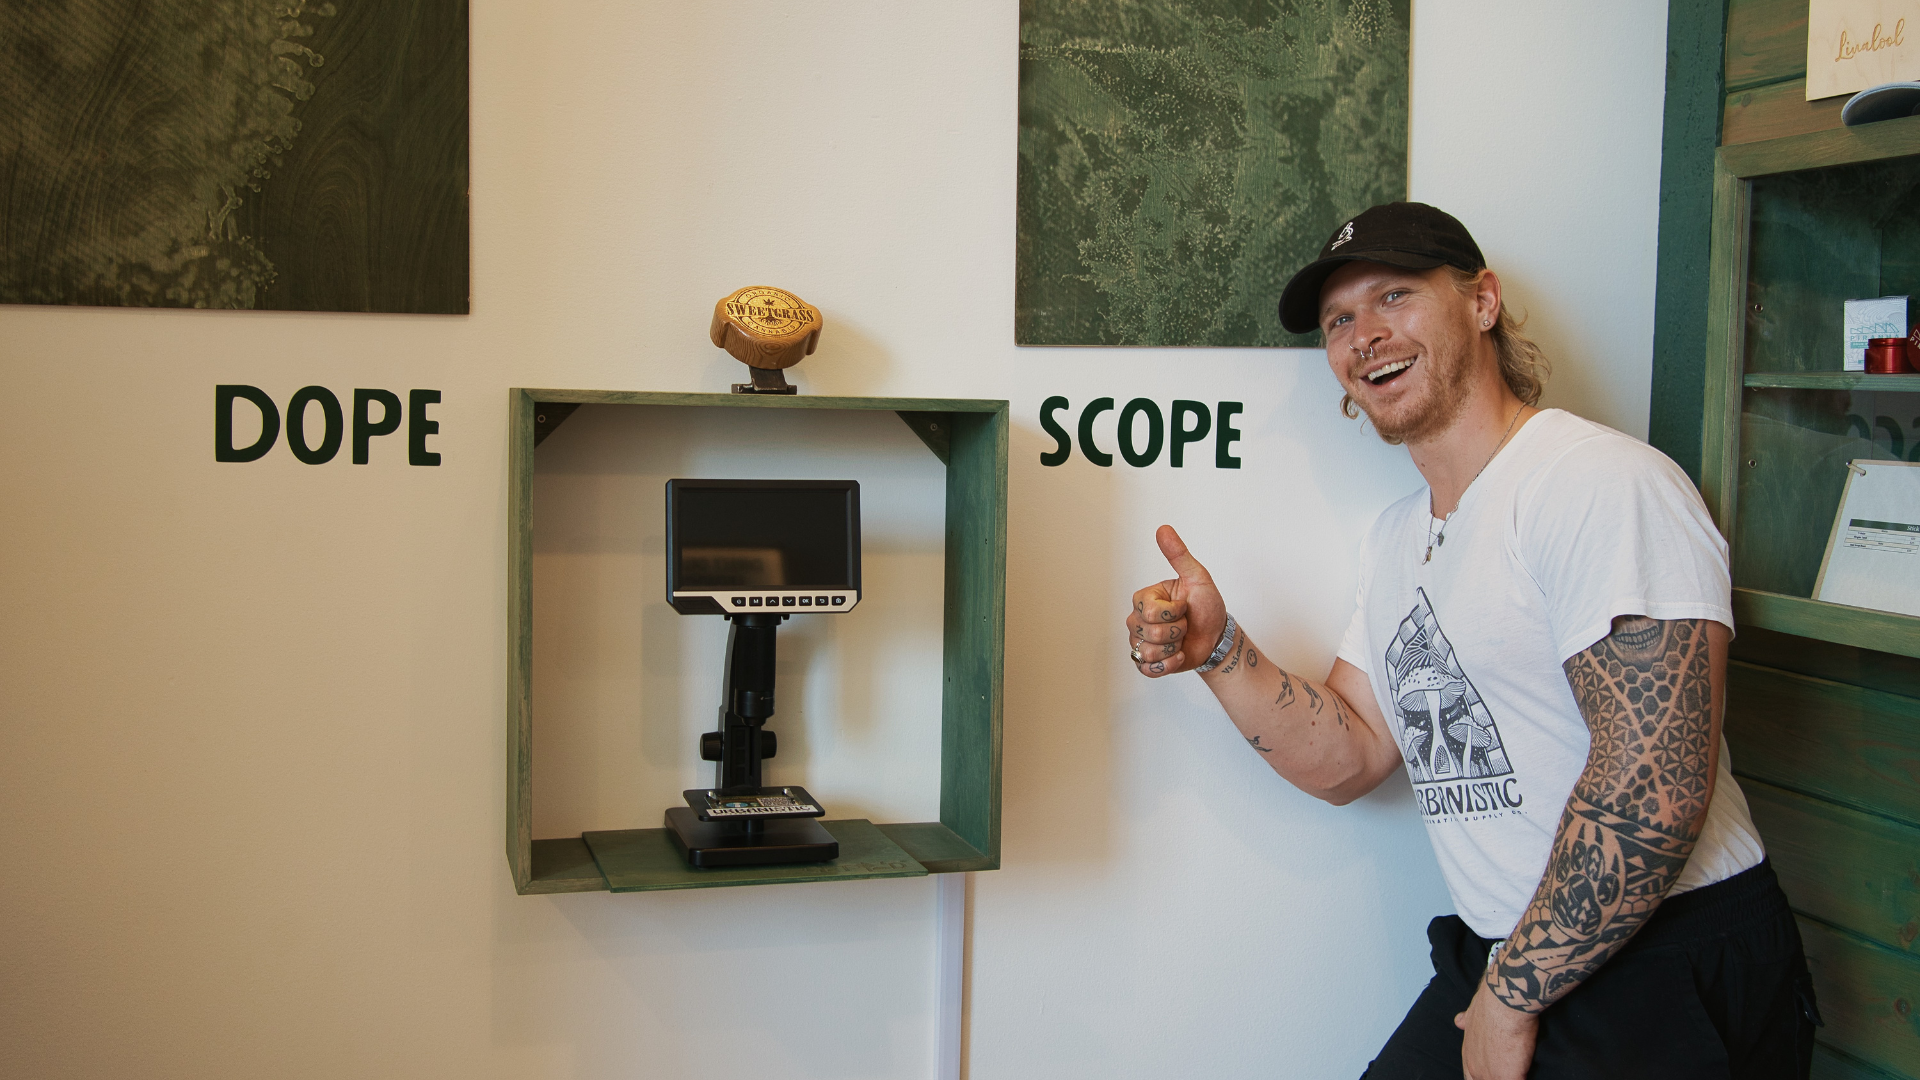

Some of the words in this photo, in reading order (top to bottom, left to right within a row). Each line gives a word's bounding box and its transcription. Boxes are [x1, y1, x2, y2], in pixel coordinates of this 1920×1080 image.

[1834, 18, 1905, 63] Linalool
[745, 290, 791, 301] ORGANIC
[726, 302, 814, 323] SWEETGRASS
[748, 321, 796, 334] CANNABIS
[215, 384, 442, 467] DOPE
[1039, 395, 1244, 470] SCOPE
[1464, 812, 1504, 822] SUPPLY
